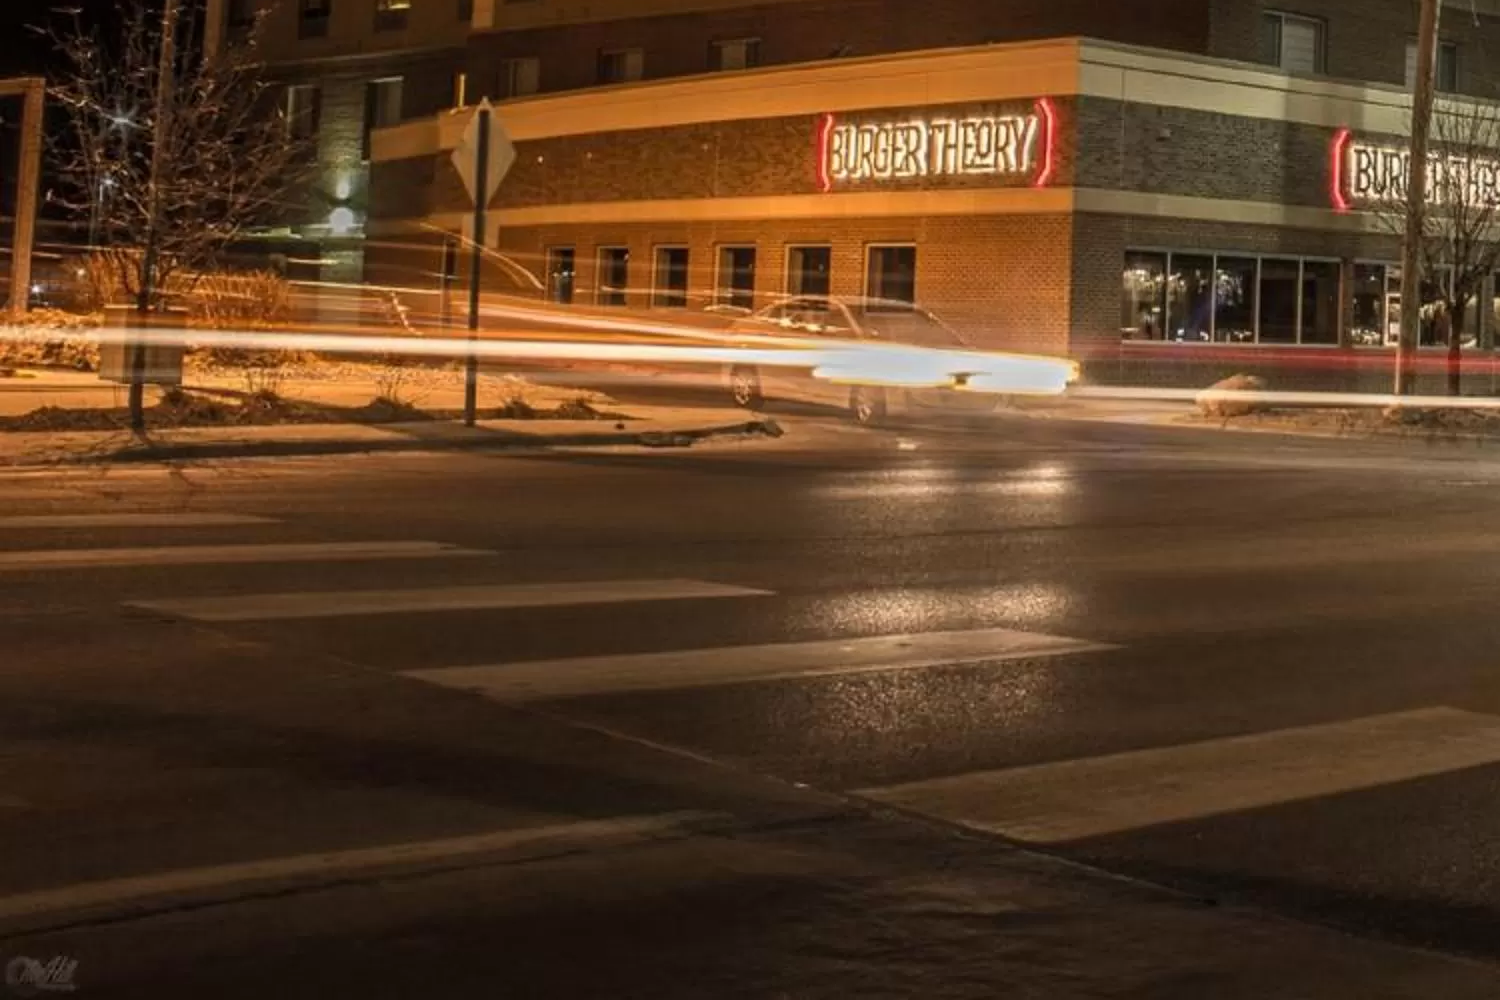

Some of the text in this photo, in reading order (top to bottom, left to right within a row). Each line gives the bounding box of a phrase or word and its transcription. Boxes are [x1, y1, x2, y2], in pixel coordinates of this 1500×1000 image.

[831, 115, 1038, 179] BURGER THEORY
[1351, 145, 1442, 204] BURR
